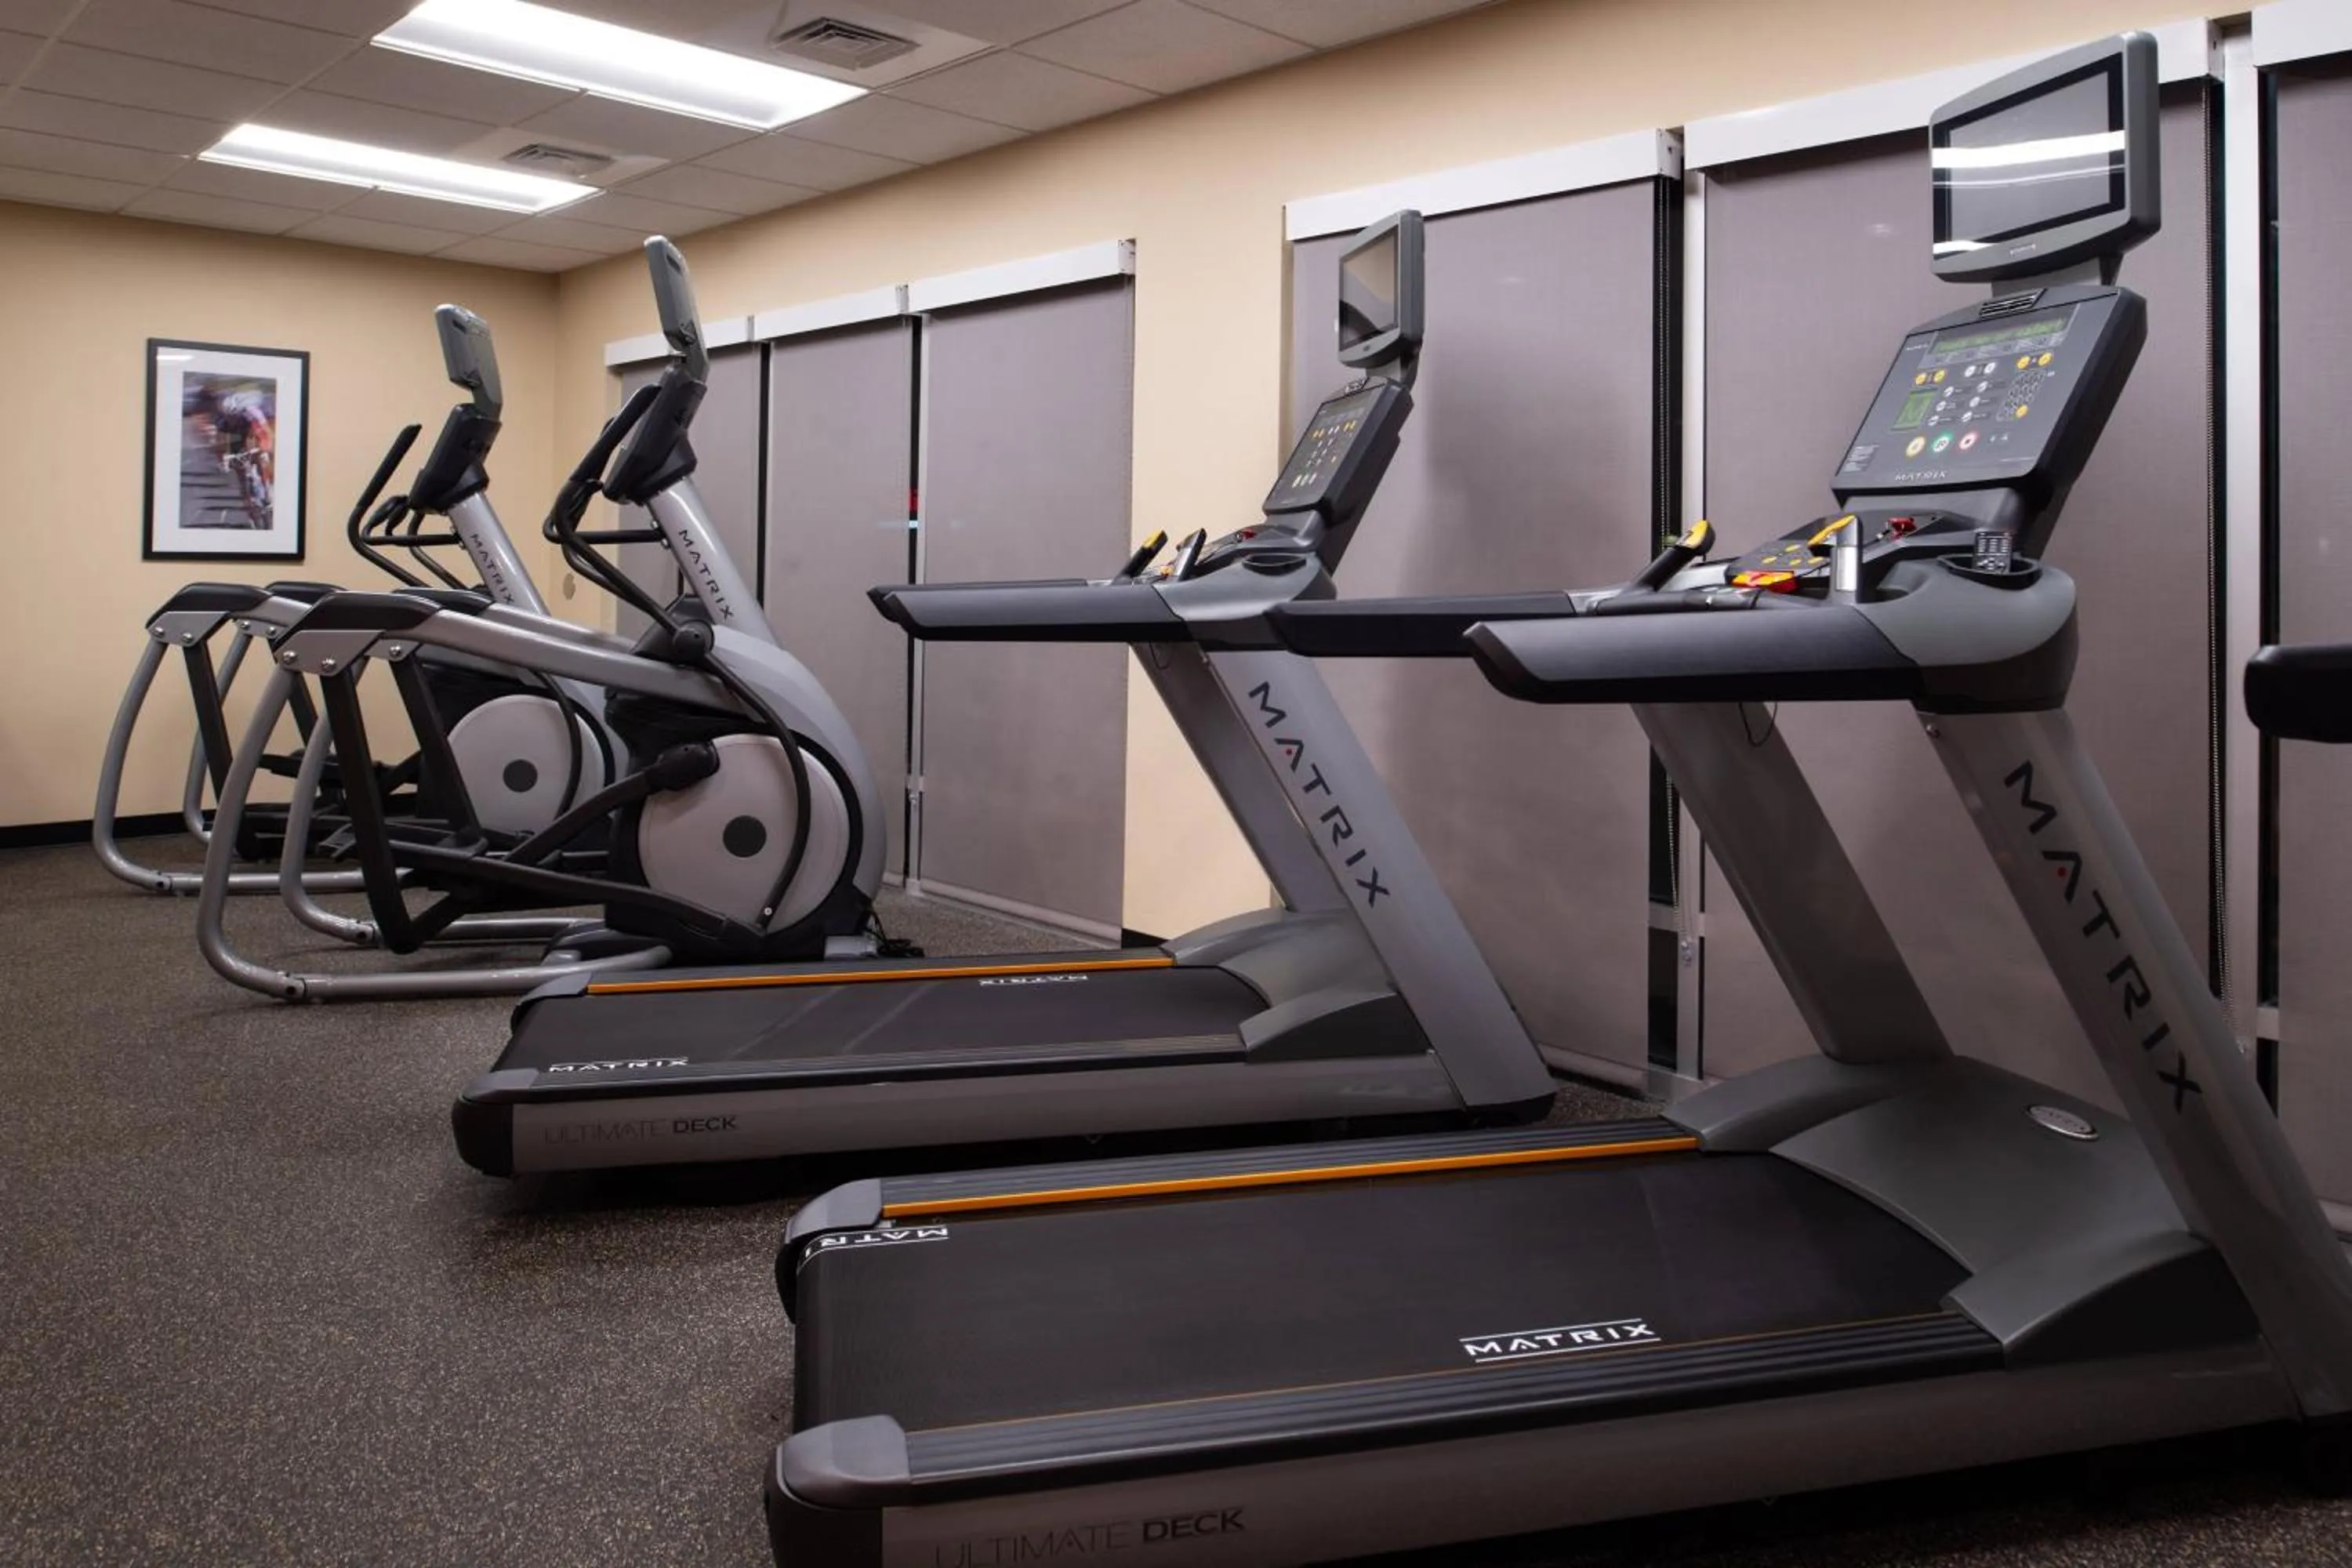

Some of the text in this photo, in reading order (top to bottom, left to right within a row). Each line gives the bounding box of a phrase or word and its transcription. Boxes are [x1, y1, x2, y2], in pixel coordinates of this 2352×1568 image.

[470, 534, 514, 604] MATRIX
[678, 529, 734, 621] MATRIX
[1248, 681, 1390, 909] MATRIX
[2004, 760, 2202, 1115] MATRIX
[550, 1058, 688, 1072] MATRIX
[544, 1116, 737, 1144] ULTIMATE DECK
[804, 1228, 948, 1258] MATRI
[1465, 1324, 1655, 1356] MATRIX
[935, 1507, 1245, 1568] ULTIMATE DECK
